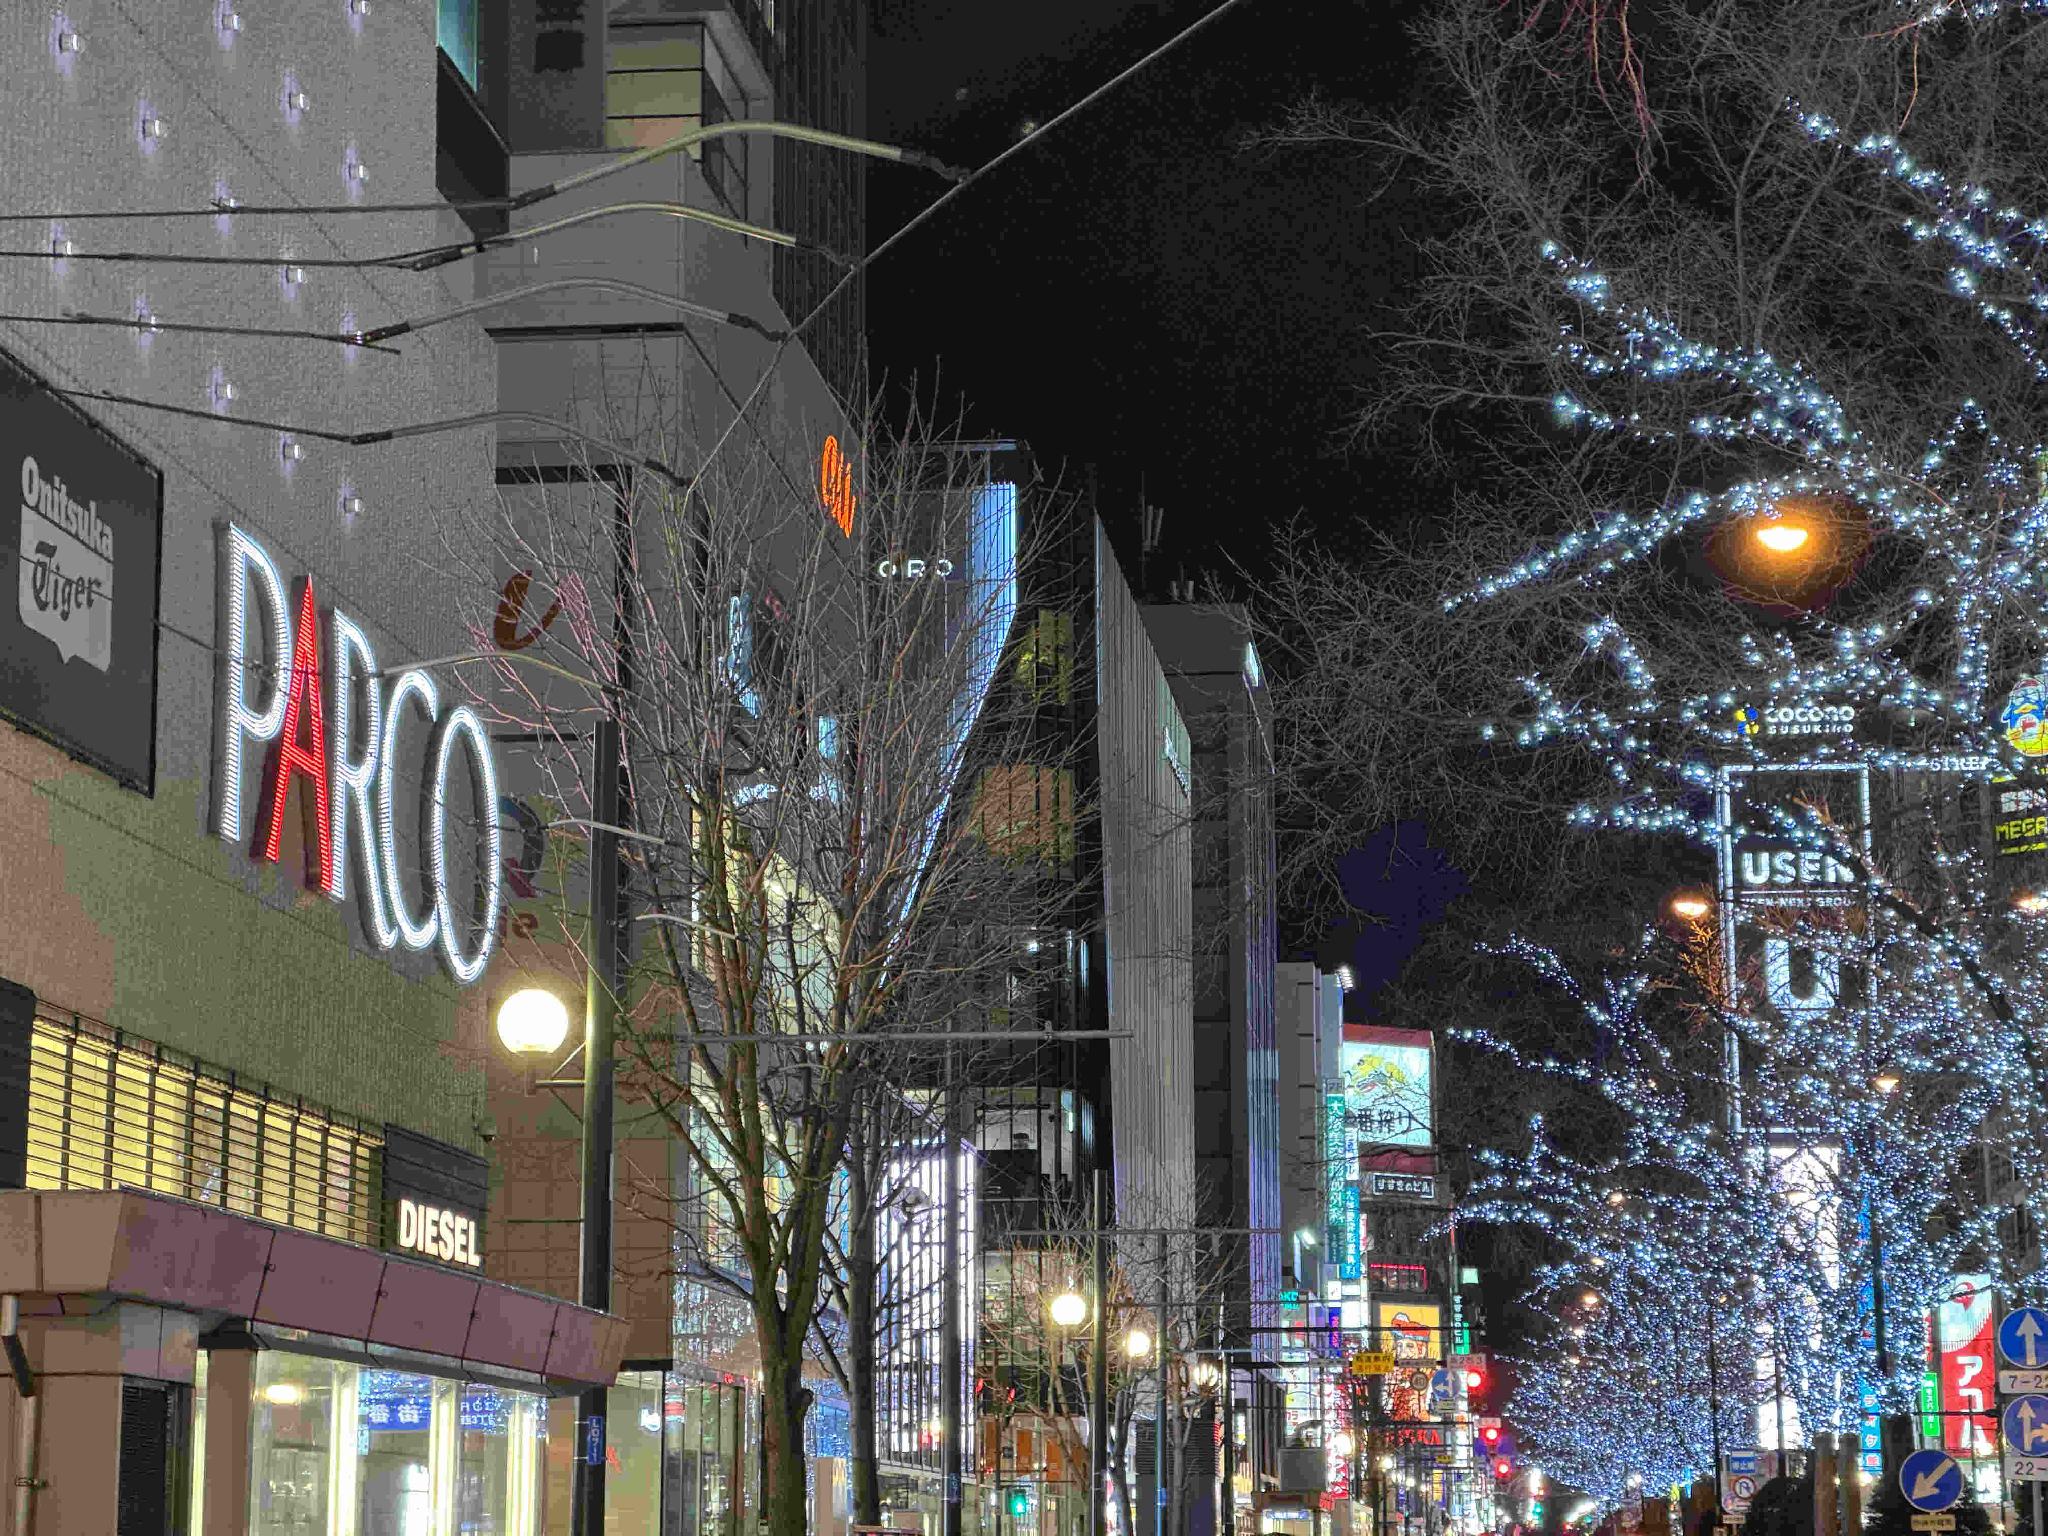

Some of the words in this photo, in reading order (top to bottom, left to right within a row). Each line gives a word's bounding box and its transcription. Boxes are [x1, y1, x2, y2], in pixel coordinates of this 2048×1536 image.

[21, 455, 113, 562] Onitsuka
[32, 541, 102, 622] Tiger
[219, 521, 501, 984] PARCO
[1740, 850, 1855, 885] USEN
[1995, 815, 2048, 842] MEGA
[399, 1199, 480, 1267] DIESEL
[1956, 1355, 1994, 1456] アコム
